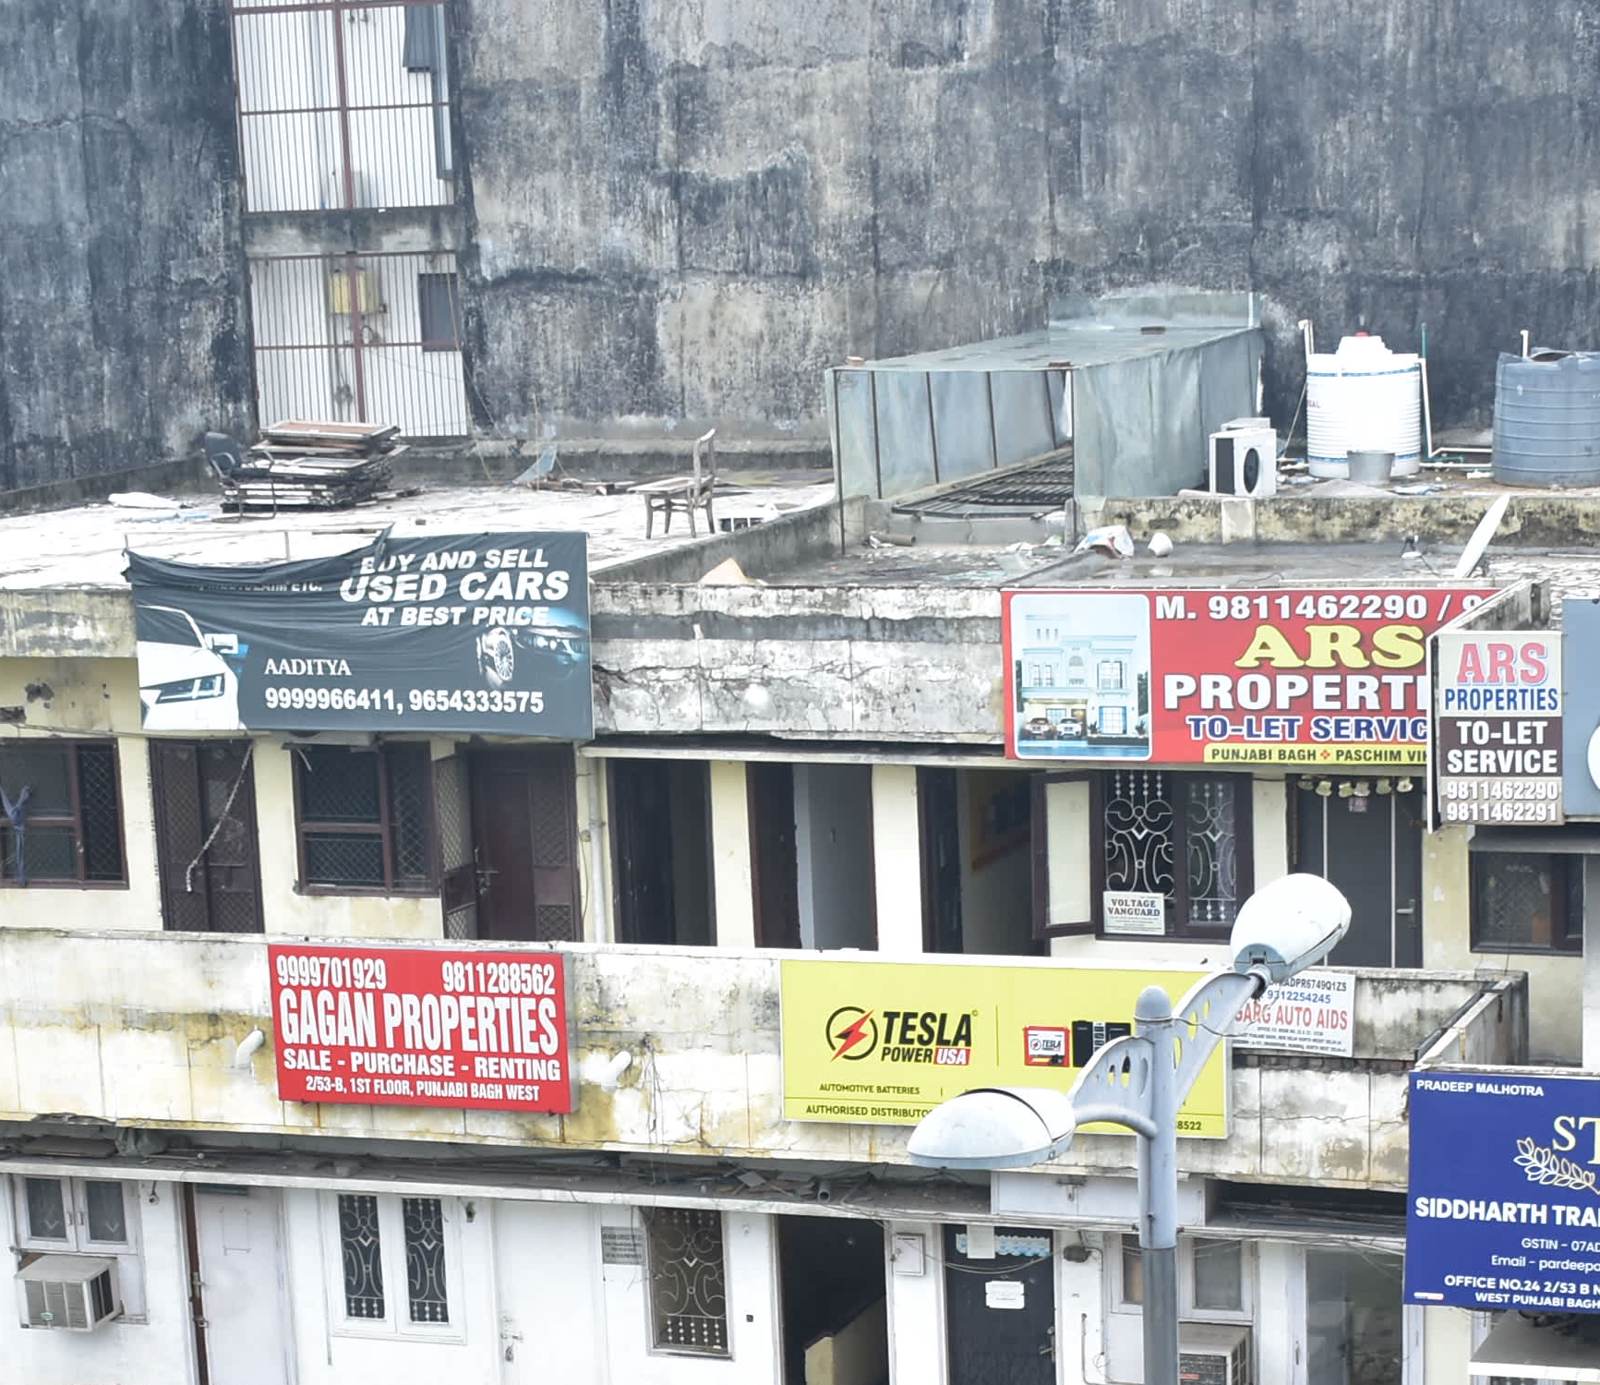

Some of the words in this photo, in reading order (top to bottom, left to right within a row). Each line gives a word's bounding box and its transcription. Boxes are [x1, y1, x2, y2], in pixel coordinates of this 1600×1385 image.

[420, 550, 477, 571] AND
[484, 548, 549, 569] SELL
[340, 572, 448, 602] USED
[459, 570, 570, 601] CARS
[361, 606, 396, 627] AT
[400, 606, 467, 626] BEST
[472, 606, 552, 627] PRICE
[1155, 594, 1197, 620] M.
[1208, 594, 1429, 620] 9811462290
[1233, 623, 1425, 669] ARS
[264, 658, 352, 677] AADITYA
[1456, 641, 1549, 686] ARS
[409, 688, 544, 714] 9654333575
[1444, 687, 1559, 711] PROPERTIES
[1186, 715, 1303, 741] TO-LET
[1456, 720, 1548, 745] TO-LET
[1211, 748, 1273, 761] PUNJABI
[1278, 748, 1317, 762] BAGH
[1335, 749, 1402, 763] PASCHIM
[1447, 749, 1558, 774] SERVICE
[1445, 781, 1559, 801] 9811462290
[1445, 801, 1558, 823] 9811462291
[1108, 907, 1160, 917] VANGUARD
[1111, 898, 1156, 908] VOLTAGE
[276, 954, 387, 990] 9999701929
[442, 960, 556, 995] 9811288562
[279, 987, 377, 1048] GAGAN
[383, 992, 560, 1056] PROPERTIES
[881, 1010, 973, 1048] TESLA
[1275, 1005, 1313, 1028] AUTO
[1316, 1009, 1348, 1031] AIDS
[283, 1048, 332, 1072] SALE
[351, 1051, 455, 1077] PURCHASE
[475, 1056, 561, 1081] RENTING
[881, 1047, 932, 1063] POWER
[936, 1048, 971, 1065] USA
[350, 1077, 371, 1093] 1ST
[374, 1078, 414, 1098] FLOOR,
[416, 1081, 468, 1098] PUNJABI
[471, 1083, 503, 1100] BAGH
[506, 1085, 540, 1102] WEST
[819, 1083, 874, 1094] AUTOMOTIVE
[876, 1085, 920, 1095] BATTERIES
[1416, 1079, 1473, 1093] PRADEEP
[1476, 1082, 1544, 1097] MALHOTRA
[806, 1104, 868, 1116] AUTHORISED
[1415, 1197, 1547, 1226] SIDDHARTH
[1551, 1204, 1600, 1228] TRA
[1521, 1237, 1558, 1250] GSTIN
[1491, 1255, 1526, 1267] Email
[1444, 1274, 1497, 1289] OFFICE
[1499, 1277, 1541, 1292] NO.24
[1543, 1280, 1577, 1294] 2/53
[1579, 1283, 1590, 1295] B
[1475, 1292, 1511, 1304] WEST
[1512, 1294, 1564, 1307] PUNJABI
[1566, 1297, 1600, 1309] BAGH
